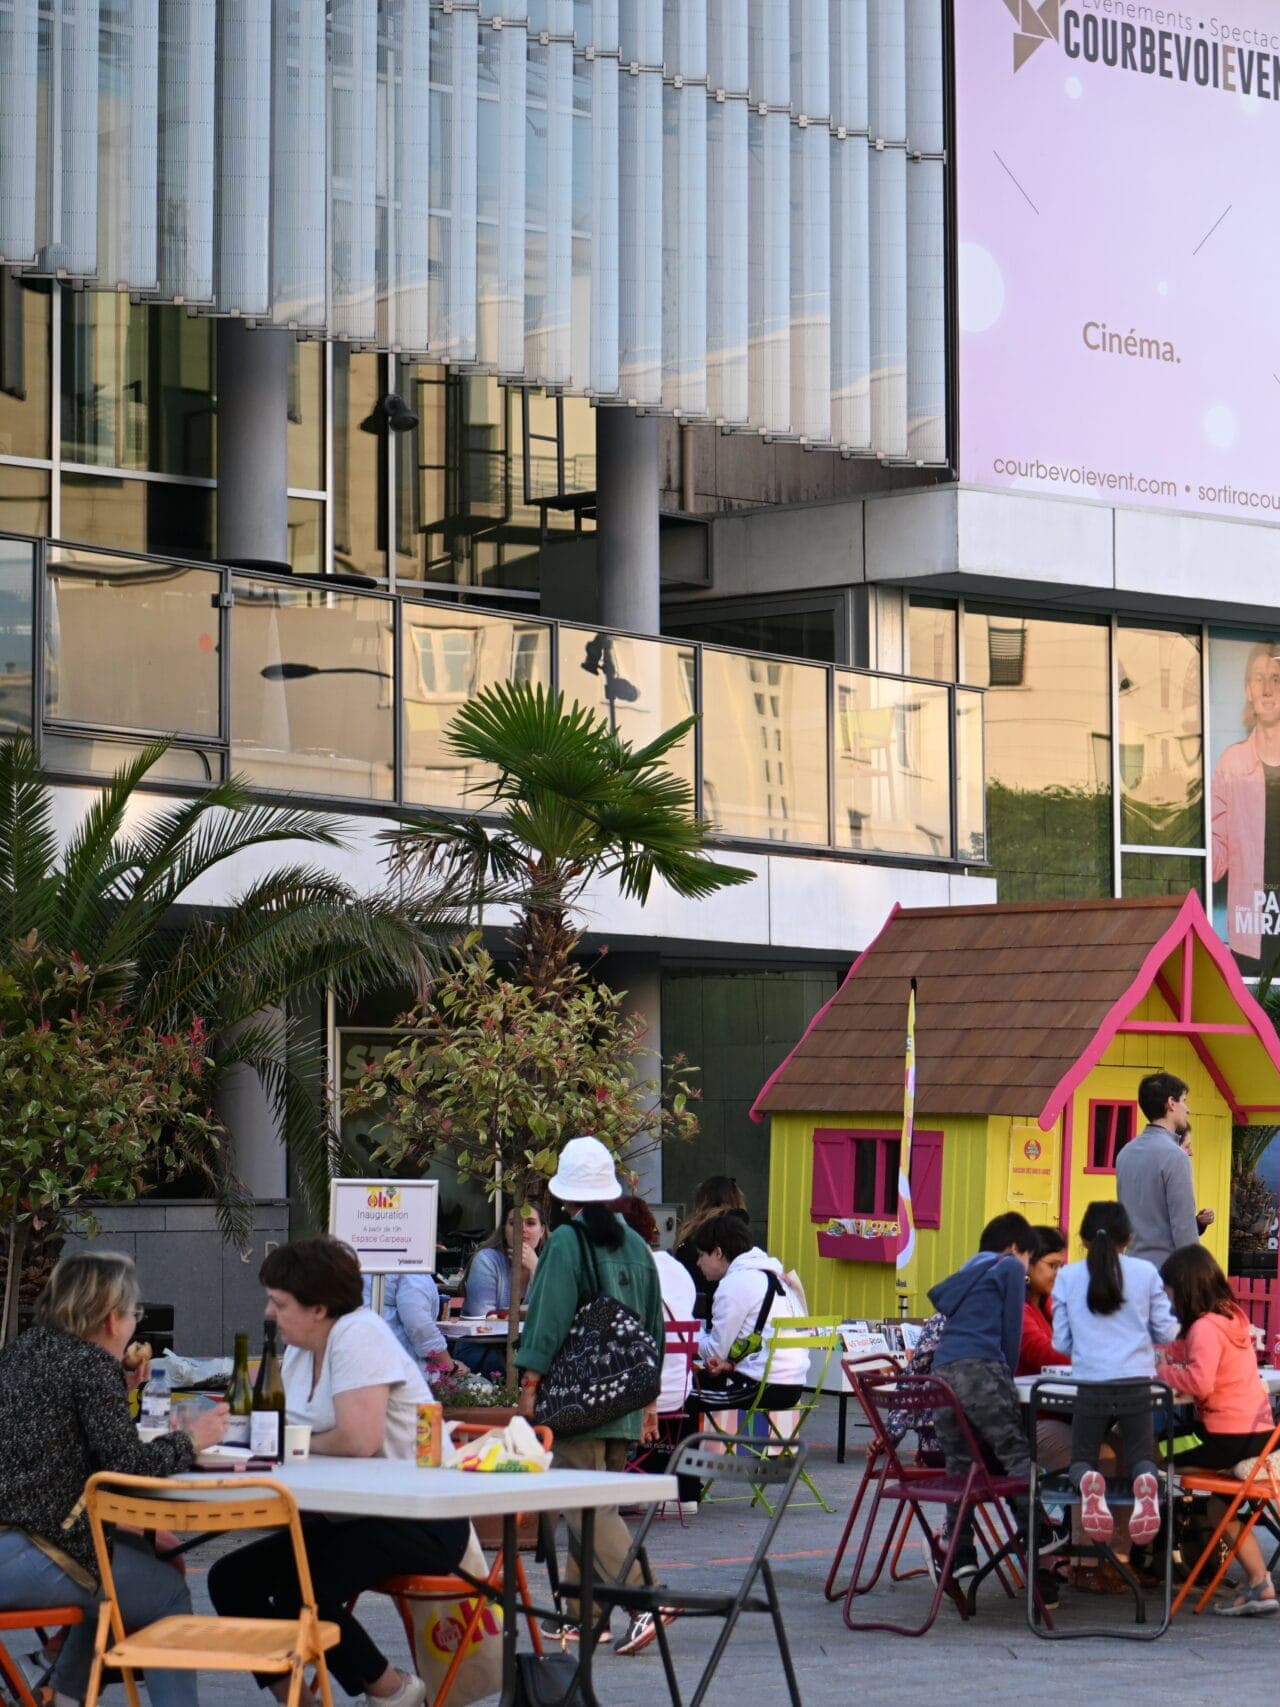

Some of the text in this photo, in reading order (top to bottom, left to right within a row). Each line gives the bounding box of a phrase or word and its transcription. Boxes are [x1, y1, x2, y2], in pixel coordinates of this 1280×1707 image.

[1082, 321, 1182, 364] Cinéma.
[993, 457, 1177, 497] courbevoievent.com
[357, 1210, 409, 1220] Inauguration
[351, 1235, 378, 1244] Espace
